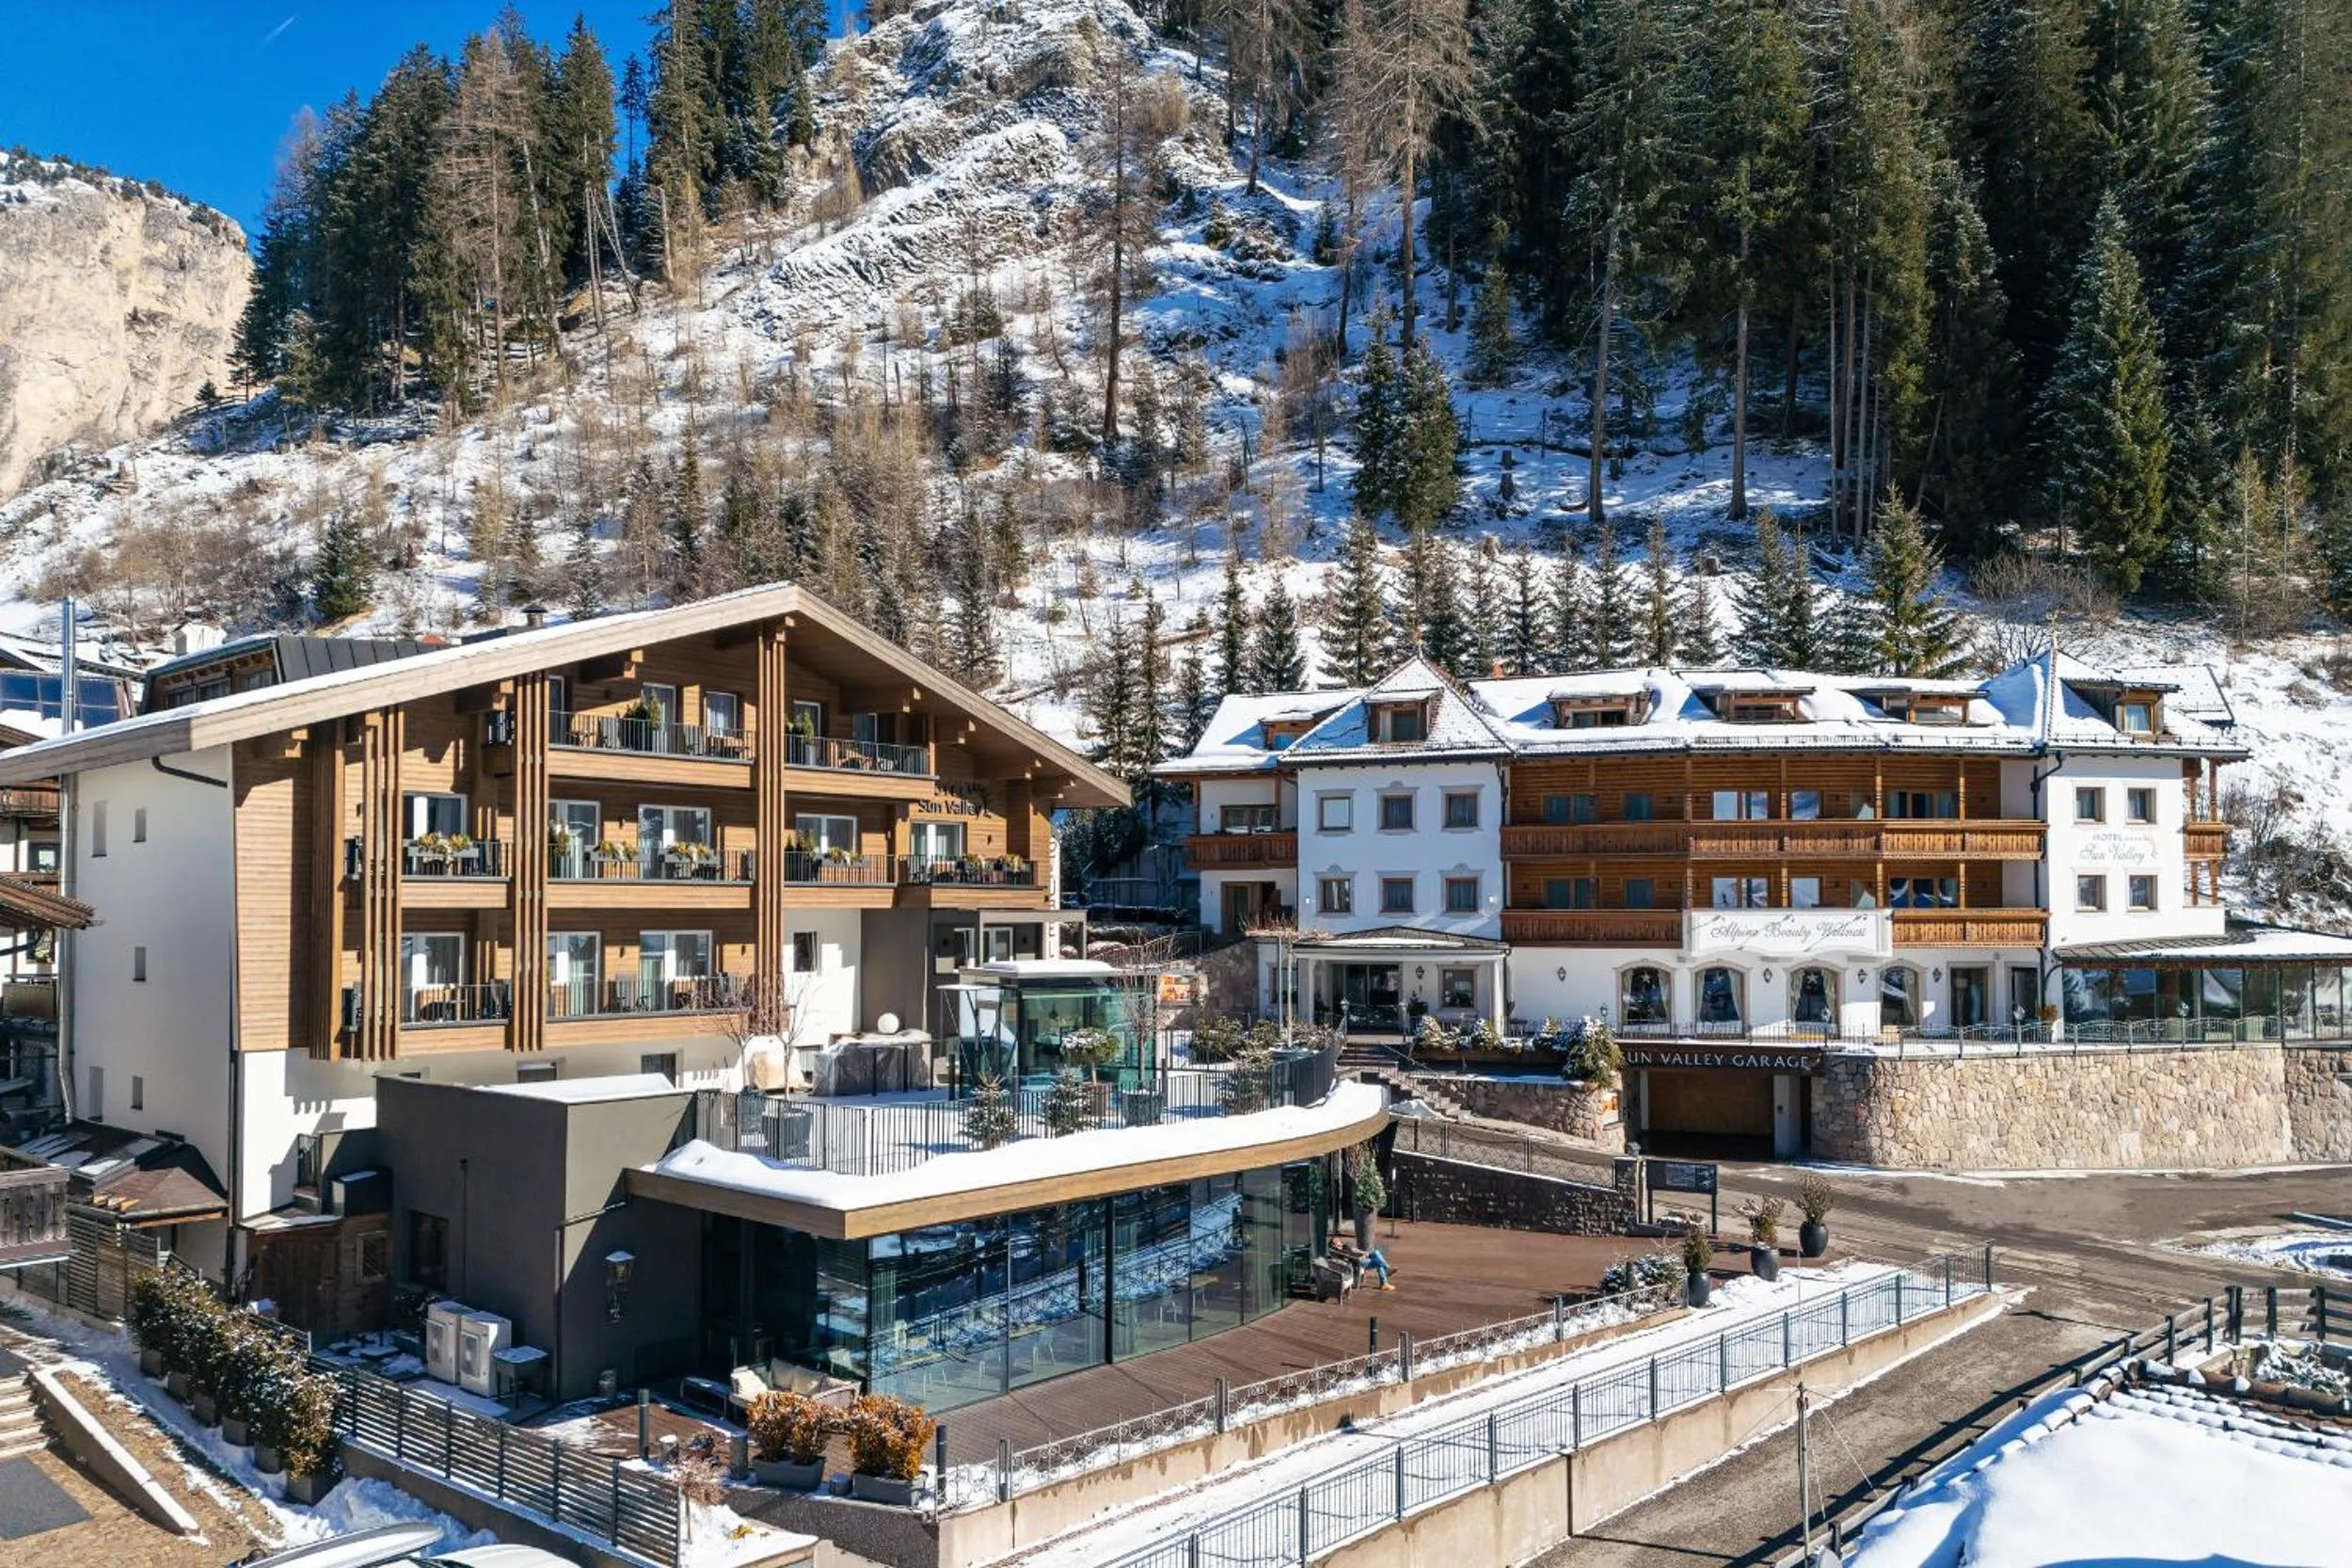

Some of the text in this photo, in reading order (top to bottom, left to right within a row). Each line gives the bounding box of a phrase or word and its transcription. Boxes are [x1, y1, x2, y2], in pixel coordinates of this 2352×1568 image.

[918, 800, 982, 820] Sun Valley
[2091, 833, 2123, 842] HOTEL
[2079, 842, 2145, 865] Sun Valley
[1710, 921, 1758, 942] Alpine
[1765, 921, 1811, 942] Beauty
[1627, 1052, 1809, 1069] UN VALLEY GARAGE
